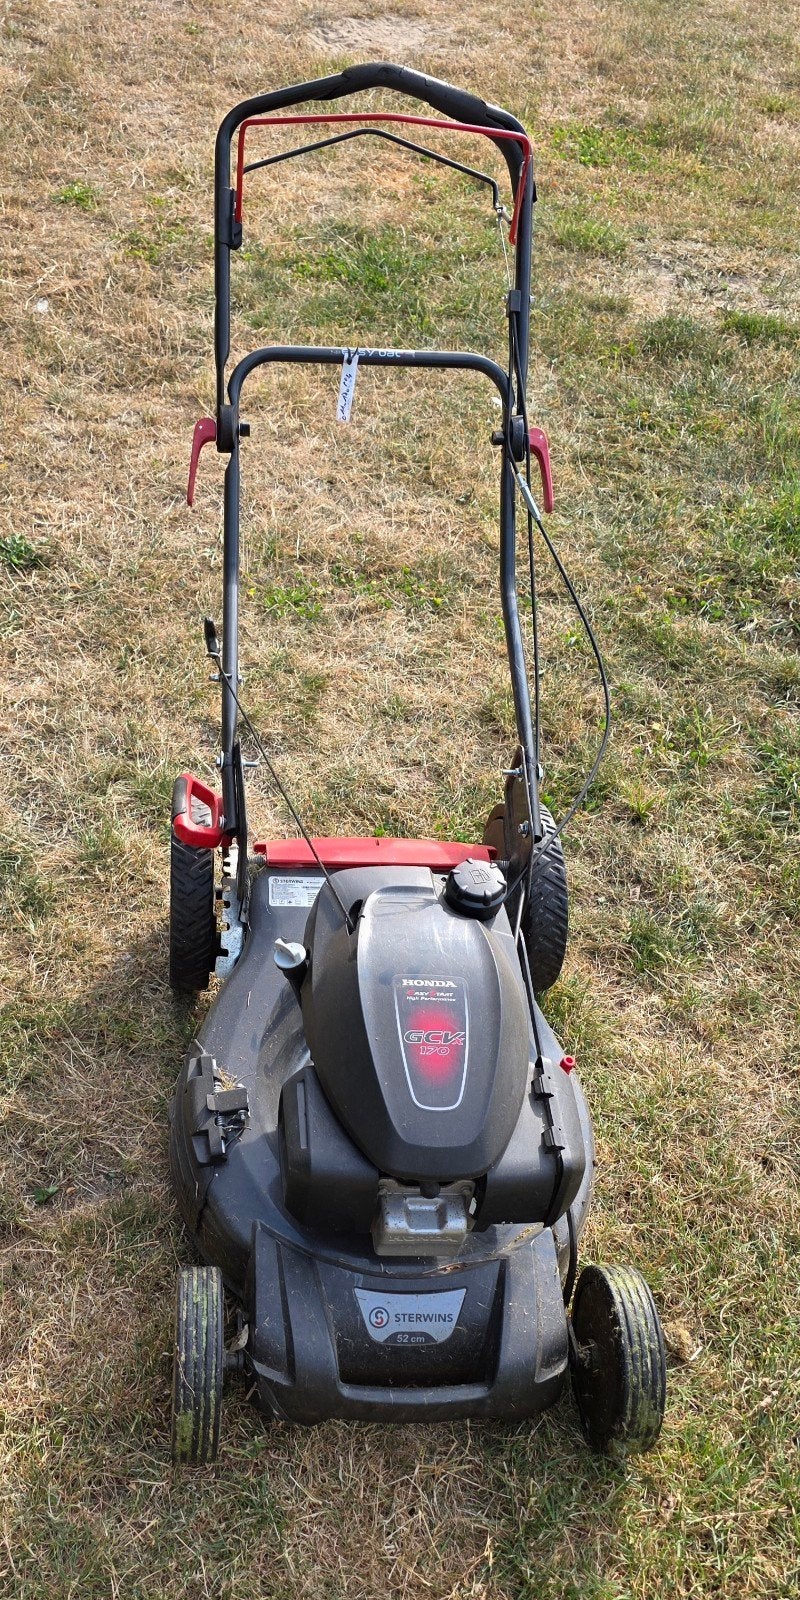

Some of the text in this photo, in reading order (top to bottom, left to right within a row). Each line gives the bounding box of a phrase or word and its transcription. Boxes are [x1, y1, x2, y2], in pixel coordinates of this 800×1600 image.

[402, 979, 458, 988] HONDA
[420, 1045, 450, 1056] 170
[394, 1313, 454, 1323] STERWINS
[396, 1334, 409, 1343] 52
